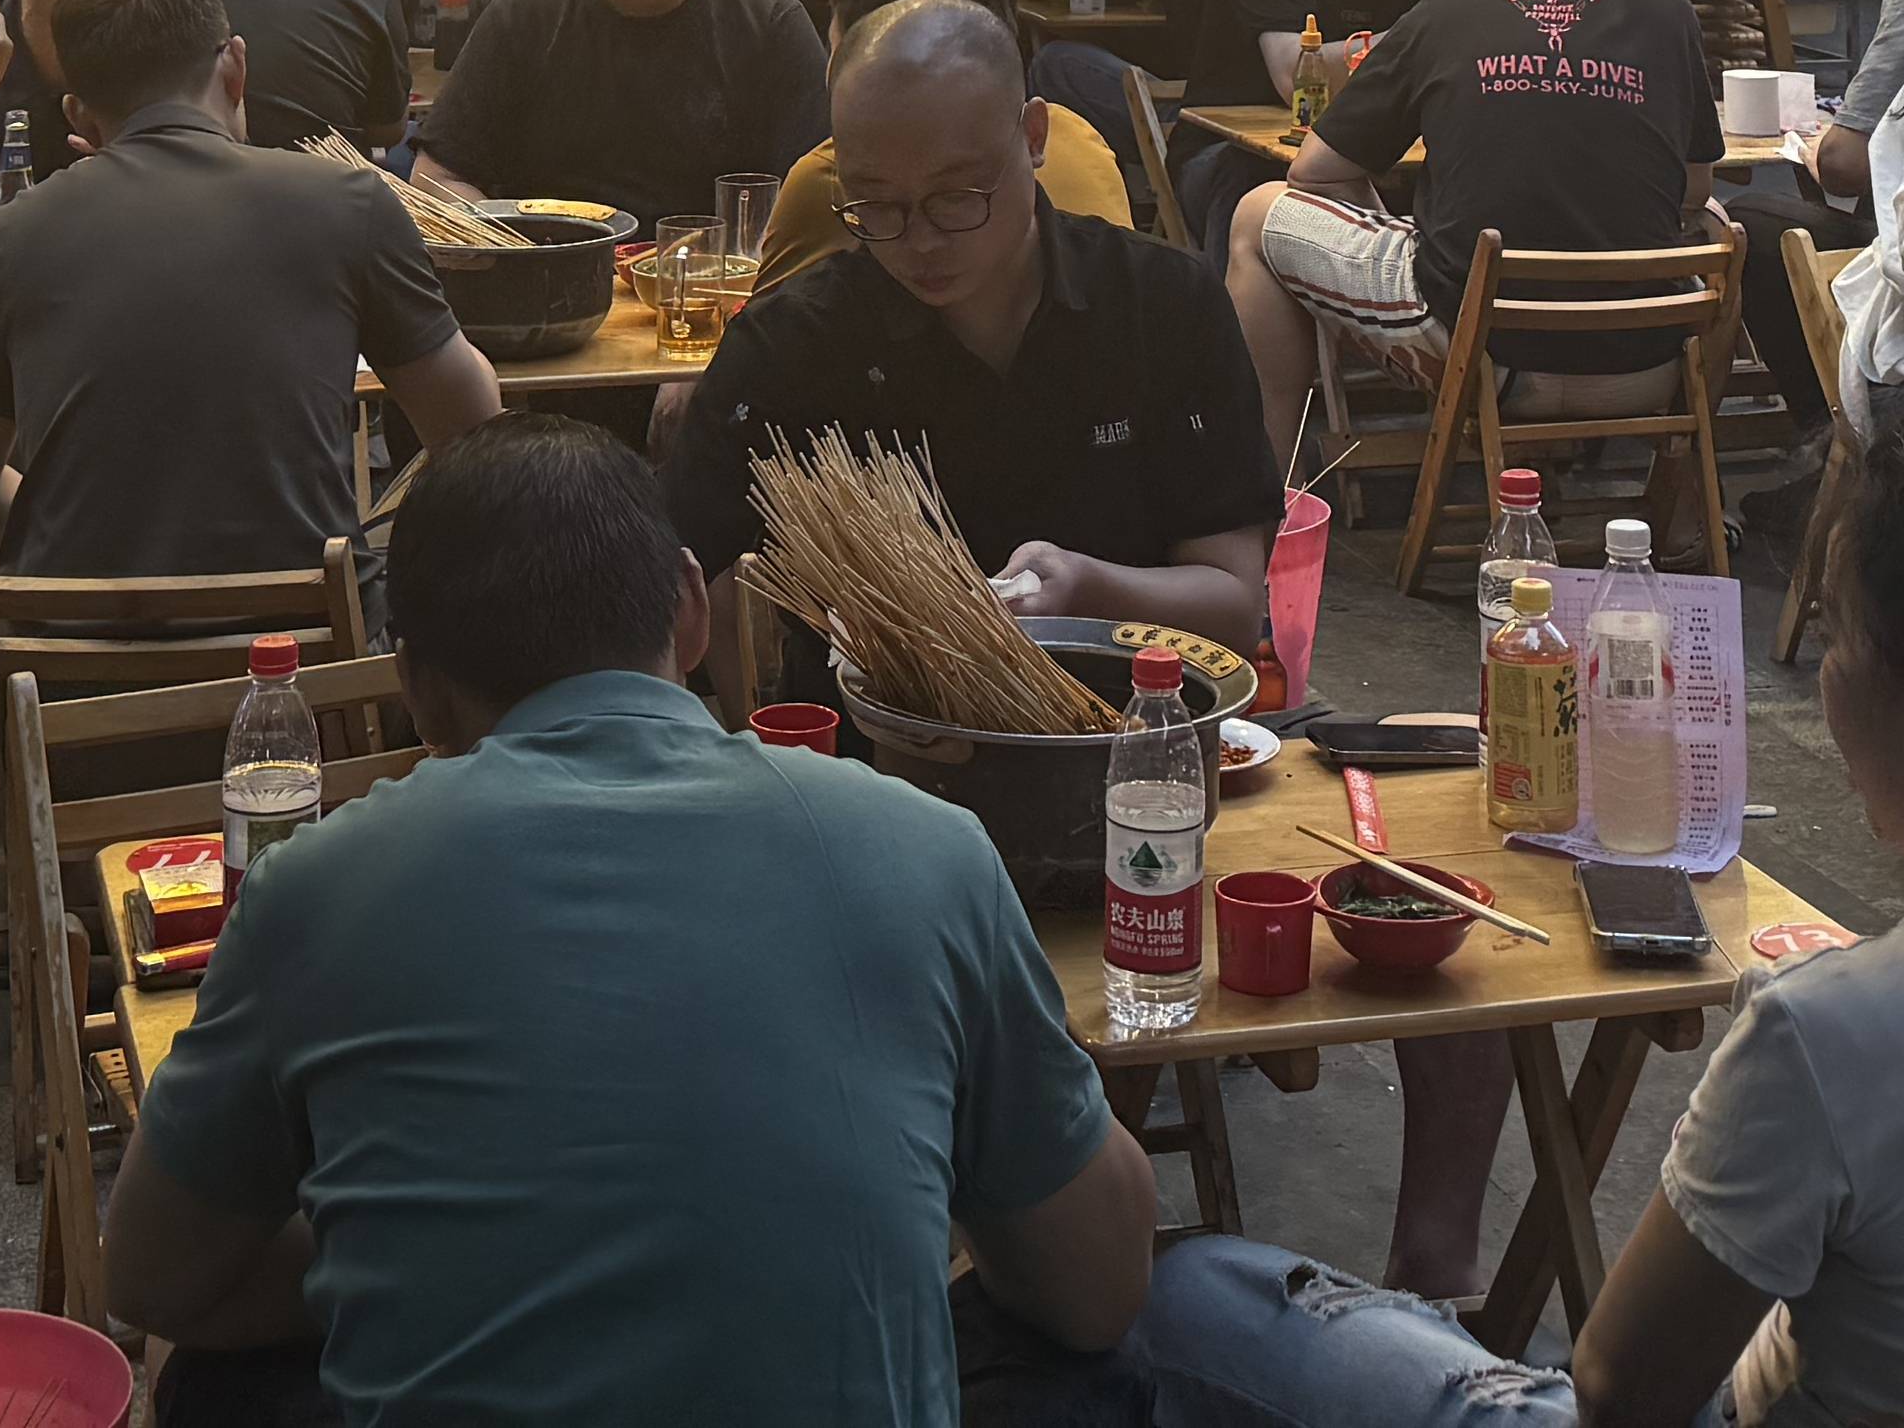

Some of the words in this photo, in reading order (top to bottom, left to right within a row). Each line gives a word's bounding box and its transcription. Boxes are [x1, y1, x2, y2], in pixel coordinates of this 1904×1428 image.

[1476, 54, 1548, 78] WHAT
[1555, 57, 1573, 77] A
[1581, 58, 1645, 91] DIVE!
[1481, 78, 1645, 105] 1-800-SKY-JUMP
[1111, 901, 1184, 932] 农夫山泉
[1147, 932, 1184, 945] SPRING
